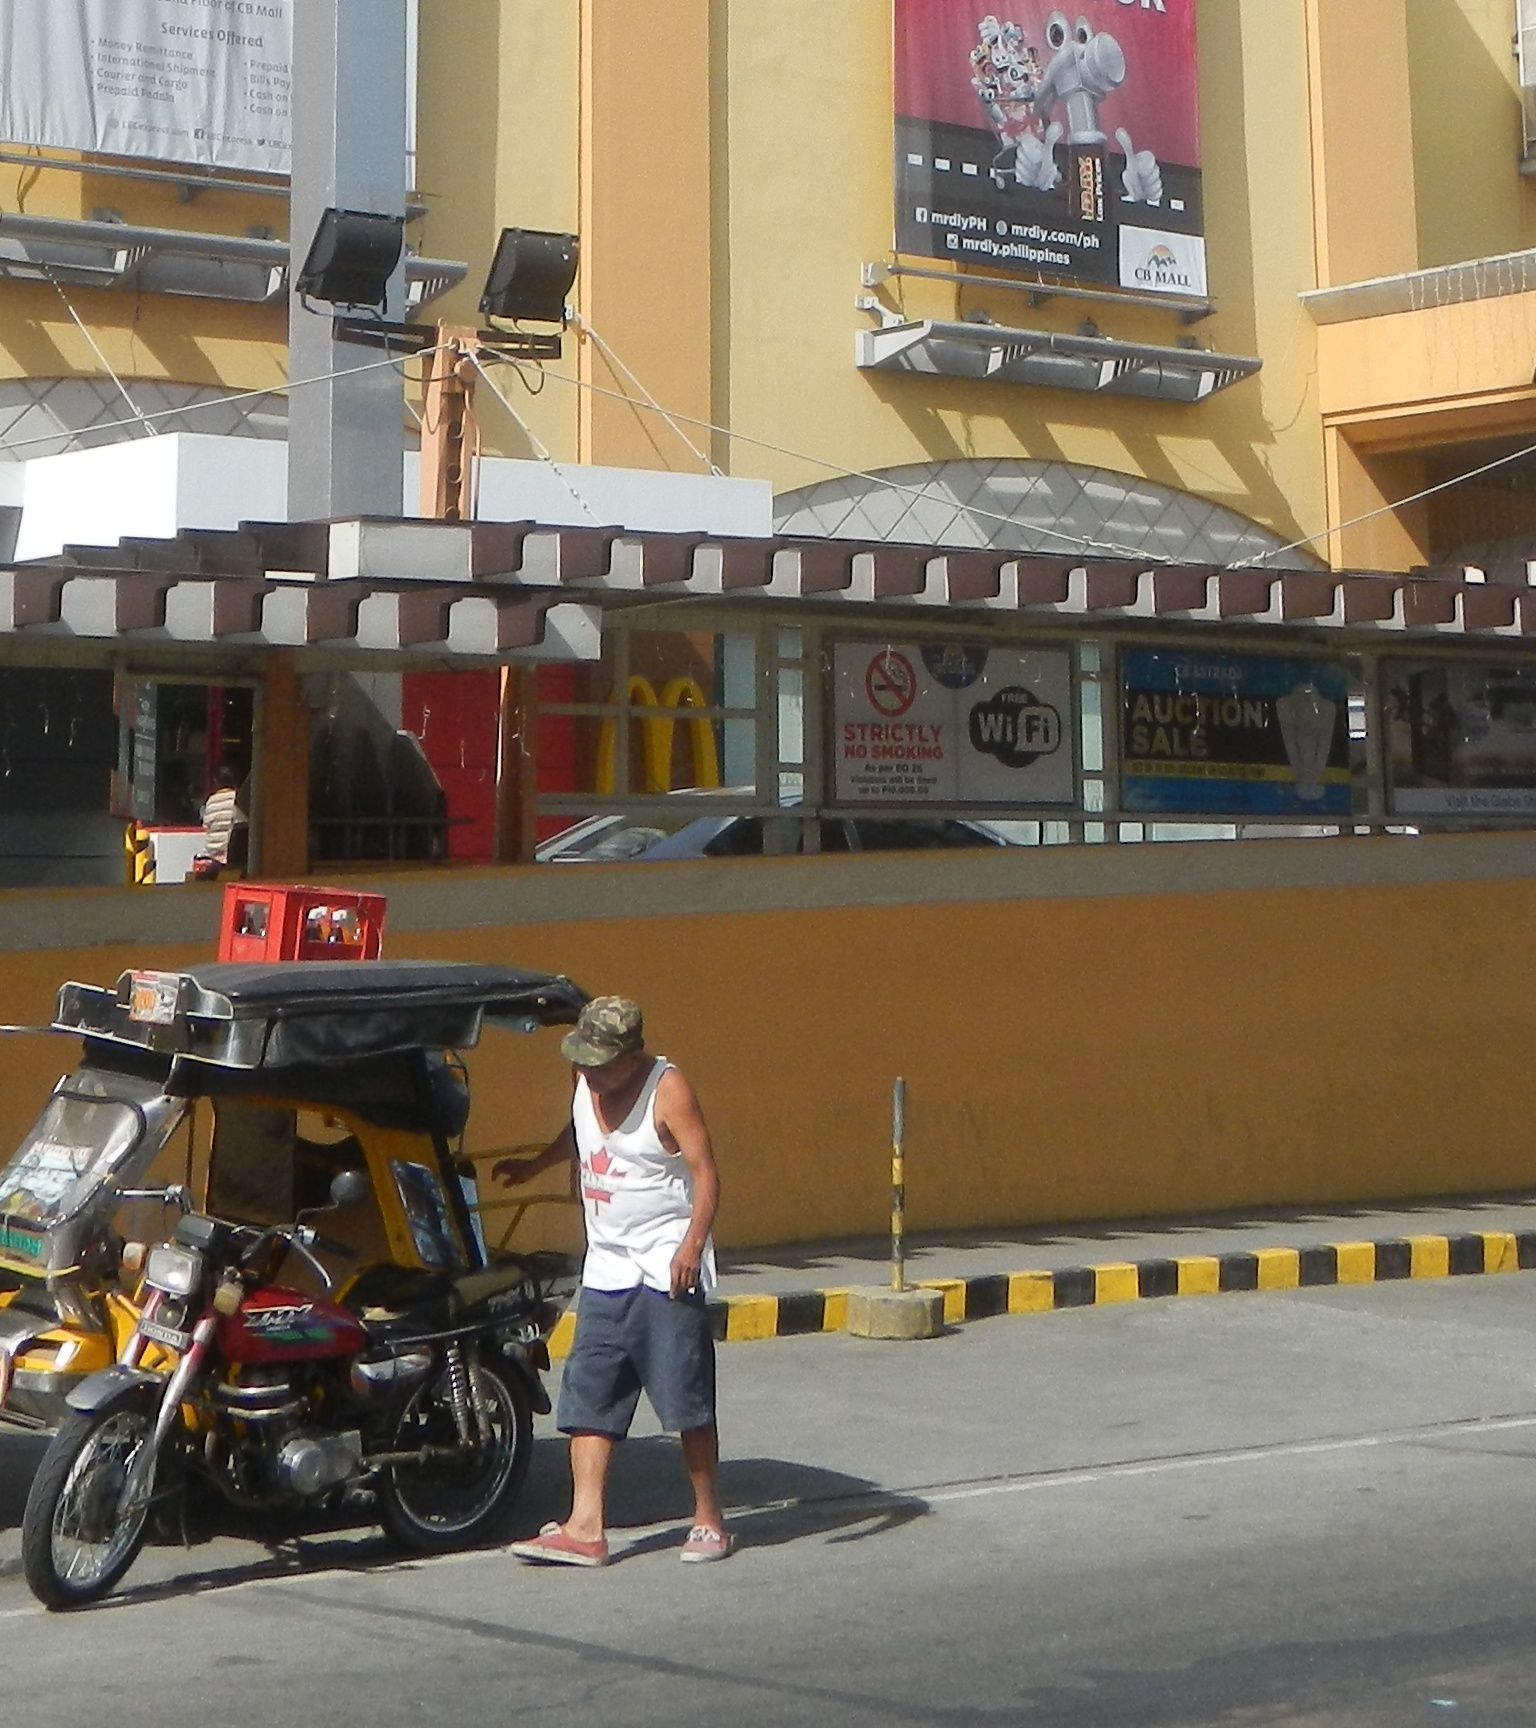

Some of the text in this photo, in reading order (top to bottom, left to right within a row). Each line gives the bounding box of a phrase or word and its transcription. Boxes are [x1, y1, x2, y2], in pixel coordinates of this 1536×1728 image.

[237, 3, 253, 14] CB
[256, 5, 282, 18] Mall
[161, 22, 263, 48] Services Offered
[98, 38, 133, 53] Money
[158, 76, 188, 90] Cargo
[1135, 267, 1191, 287] CB MALL
[1132, 693, 1263, 729] AUCTION
[844, 723, 943, 742] STRICTLY
[1132, 724, 1209, 758] SALE
[844, 745, 944, 759] NO SMOKING
[143, 1322, 182, 1345] HONDA
